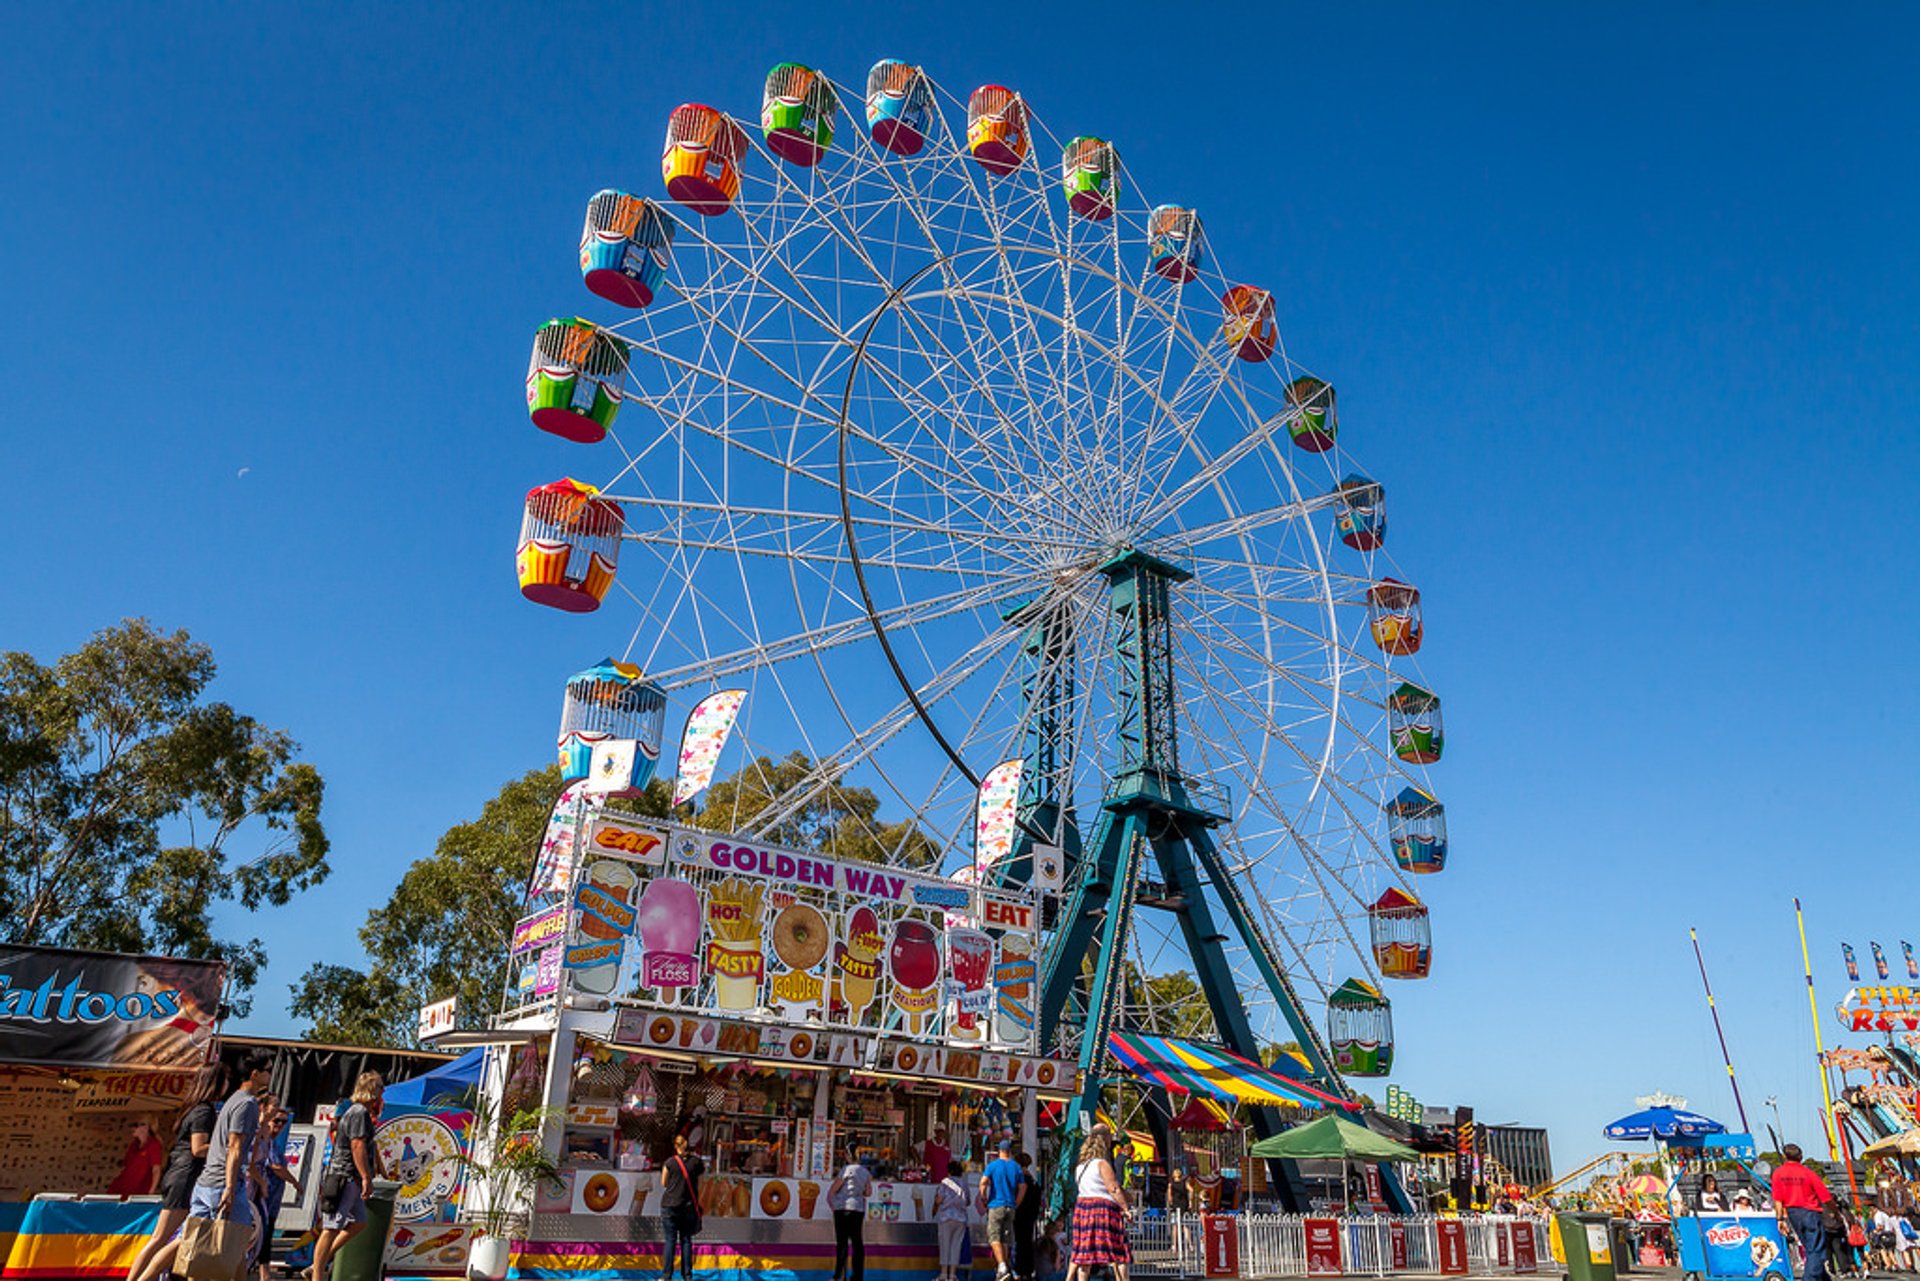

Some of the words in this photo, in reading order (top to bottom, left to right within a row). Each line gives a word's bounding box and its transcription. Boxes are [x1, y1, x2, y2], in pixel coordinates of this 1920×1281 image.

[595, 827, 661, 856] EAT
[709, 842, 835, 887] GOLDEN
[845, 867, 906, 900] WAY
[579, 888, 634, 927] GOLDEN
[710, 904, 742, 921] HOT
[985, 900, 1030, 928] EAT
[567, 943, 621, 964] CRISPY
[709, 947, 762, 973] TASTY
[840, 953, 877, 978] TASTY
[651, 969, 690, 982] FLOSS
[774, 973, 821, 998] GOLDEN
[894, 991, 937, 1008] DELICIOUS
[1857, 986, 1920, 1006] PIR
[105, 1072, 191, 1095] TATTOO
[1707, 1225, 1750, 1245] Peters
